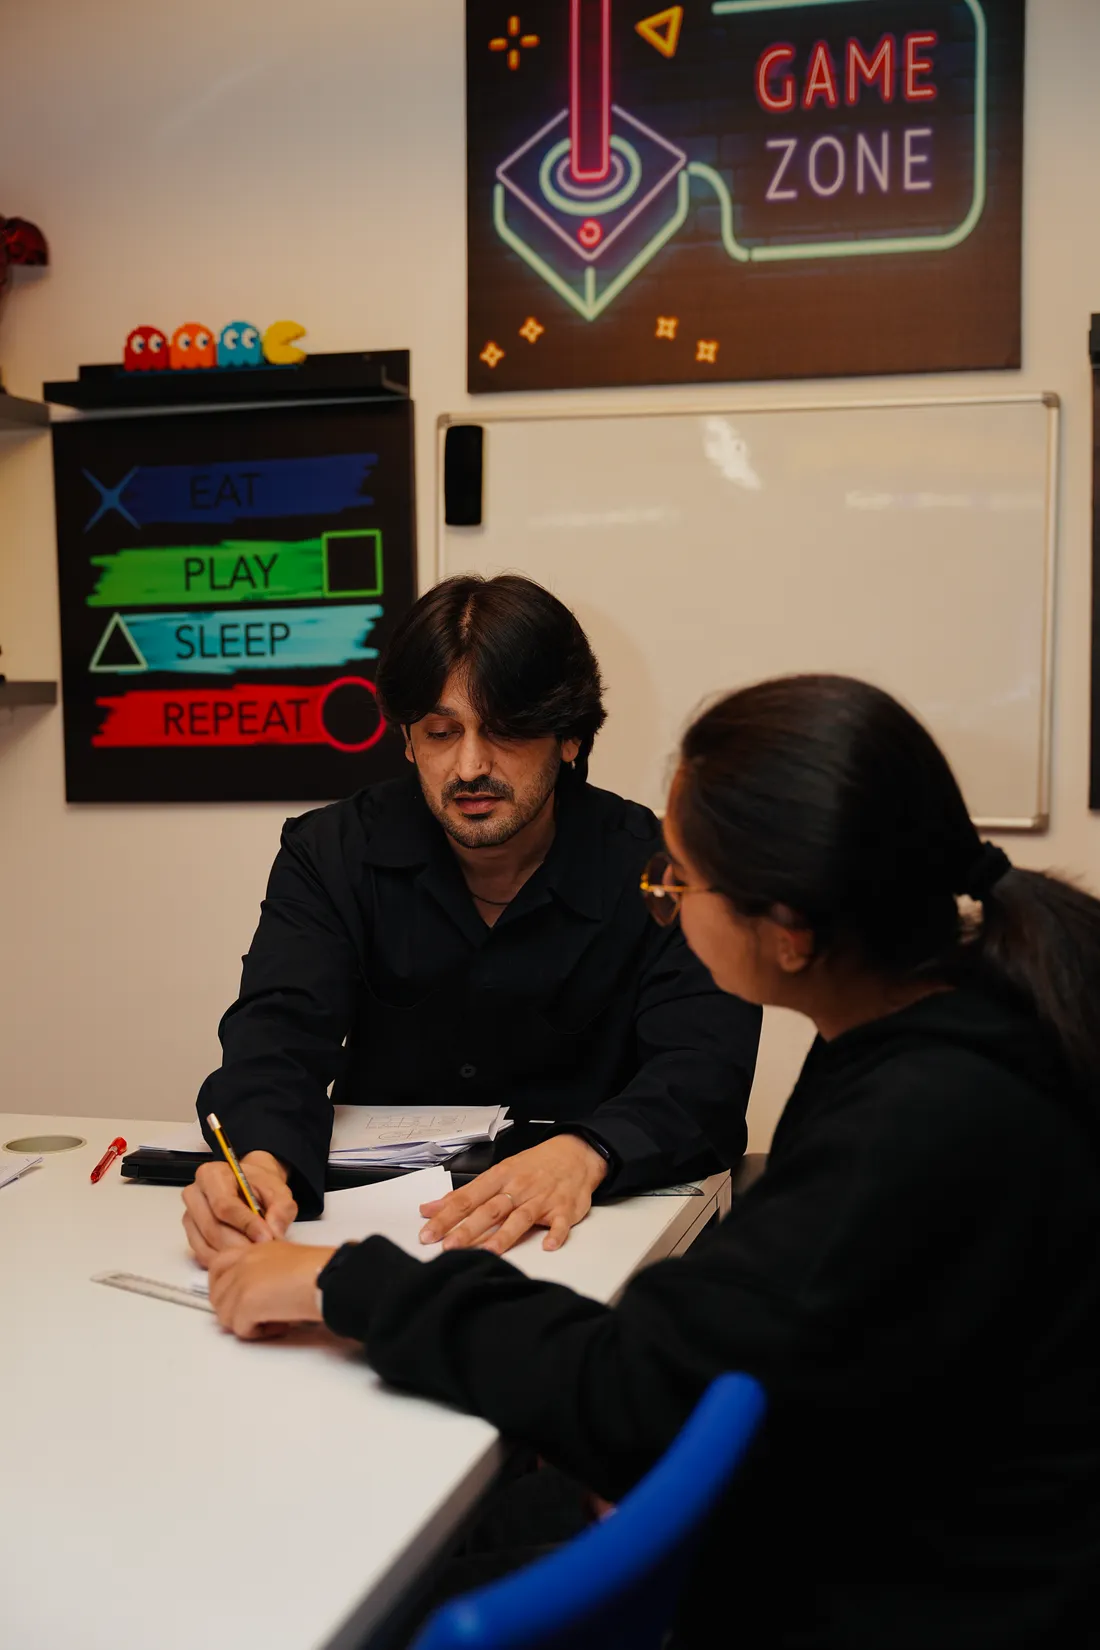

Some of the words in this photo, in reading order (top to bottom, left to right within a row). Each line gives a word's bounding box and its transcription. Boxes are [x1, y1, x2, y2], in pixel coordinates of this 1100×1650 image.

[757, 33, 937, 111] GAME
[766, 128, 932, 200] ZONE
[191, 473, 261, 509] EAT
[184, 554, 279, 591] PLAY
[175, 623, 290, 660] SLEEP
[163, 699, 310, 736] REPEAT
